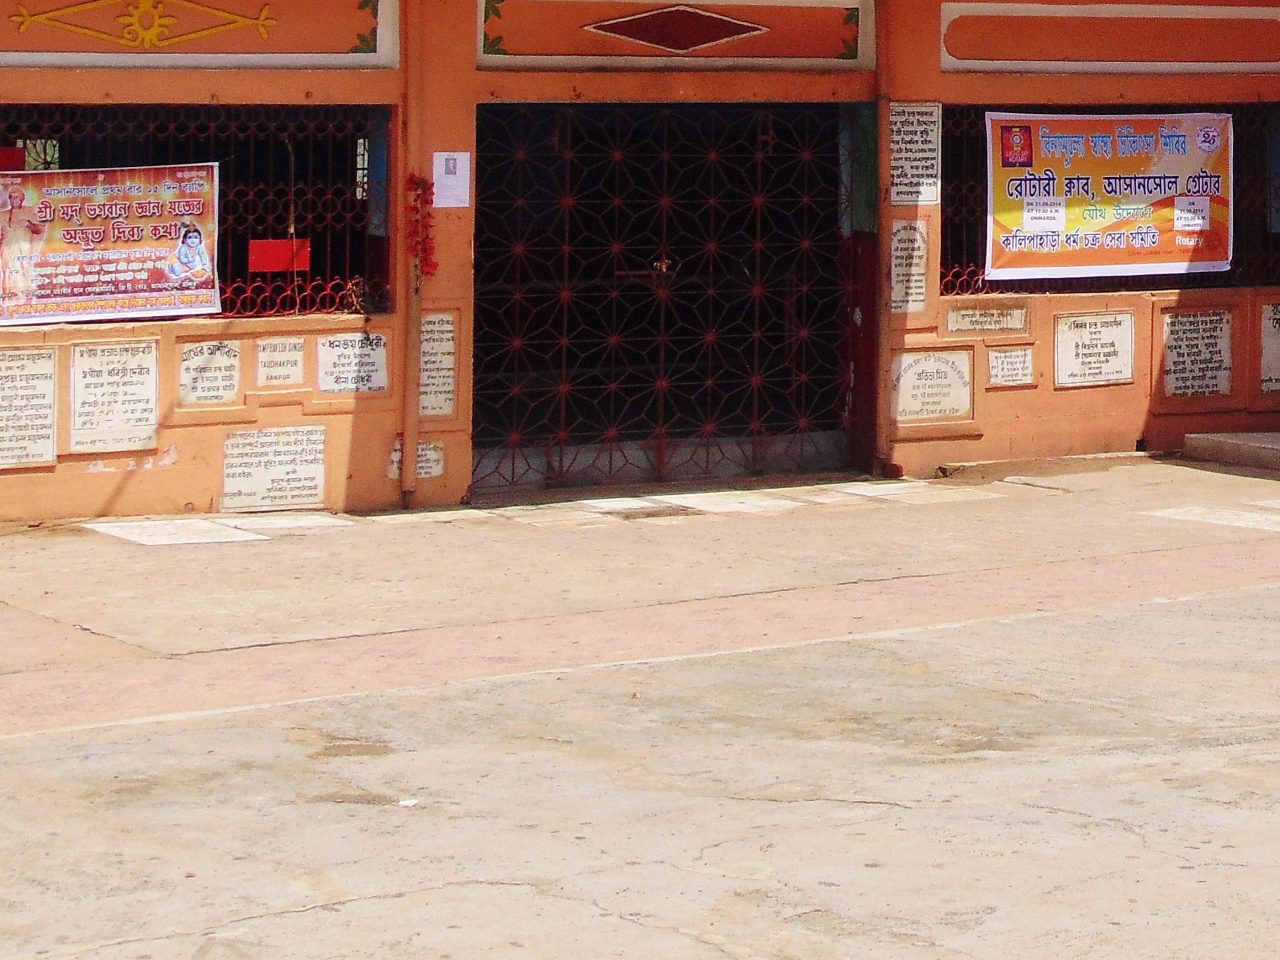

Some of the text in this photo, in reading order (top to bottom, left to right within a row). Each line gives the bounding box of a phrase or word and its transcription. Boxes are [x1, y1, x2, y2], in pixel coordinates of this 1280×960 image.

[126, 183, 142, 194] বার
[1007, 169, 1221, 201] রোটারী ক্লাব, আসানসোল গ্রেটার
[37, 200, 54, 221] শ্রী
[134, 201, 162, 216] জ্ঞান
[1082, 202, 1106, 220] যৌথ
[111, 221, 142, 241] দিব্য
[150, 222, 180, 240] কথা
[1064, 230, 1079, 250] ধর্ম
[1084, 232, 1101, 248] চক্র
[1104, 231, 1126, 248] সেবা
[1130, 227, 1159, 248] সমিতি
[1175, 236, 1203, 247] Rotary
